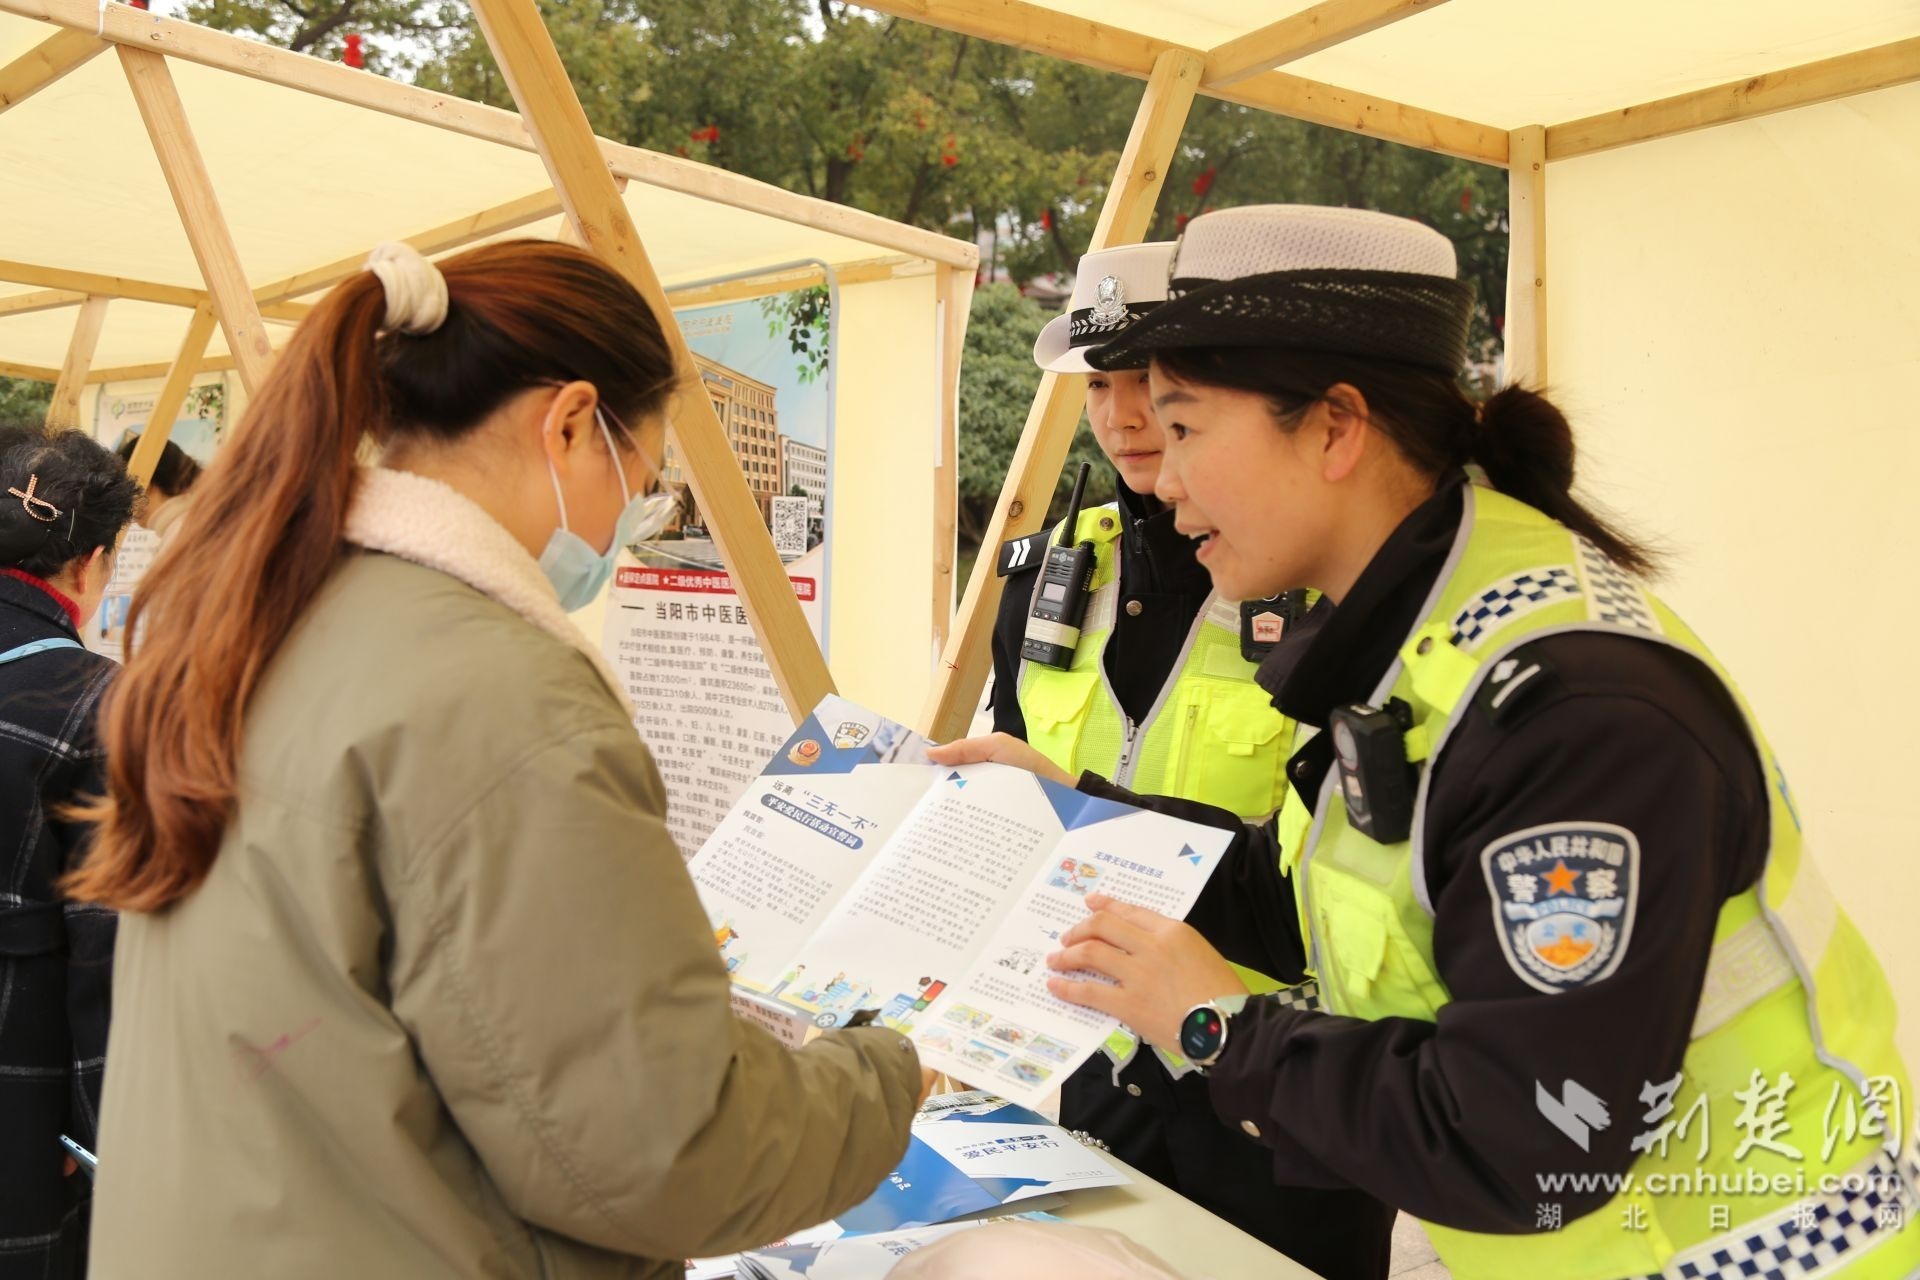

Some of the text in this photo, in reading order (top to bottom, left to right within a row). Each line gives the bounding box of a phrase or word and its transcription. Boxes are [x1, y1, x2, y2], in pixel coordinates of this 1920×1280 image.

[670, 574, 733, 590] 二级优秀中医医
[656, 601, 748, 625] 当阳市中医医
[772, 780, 793, 796] 远离
[1497, 835, 1625, 873] 中华人民共和国
[962, 1141, 1059, 1160] 爱民平安行
